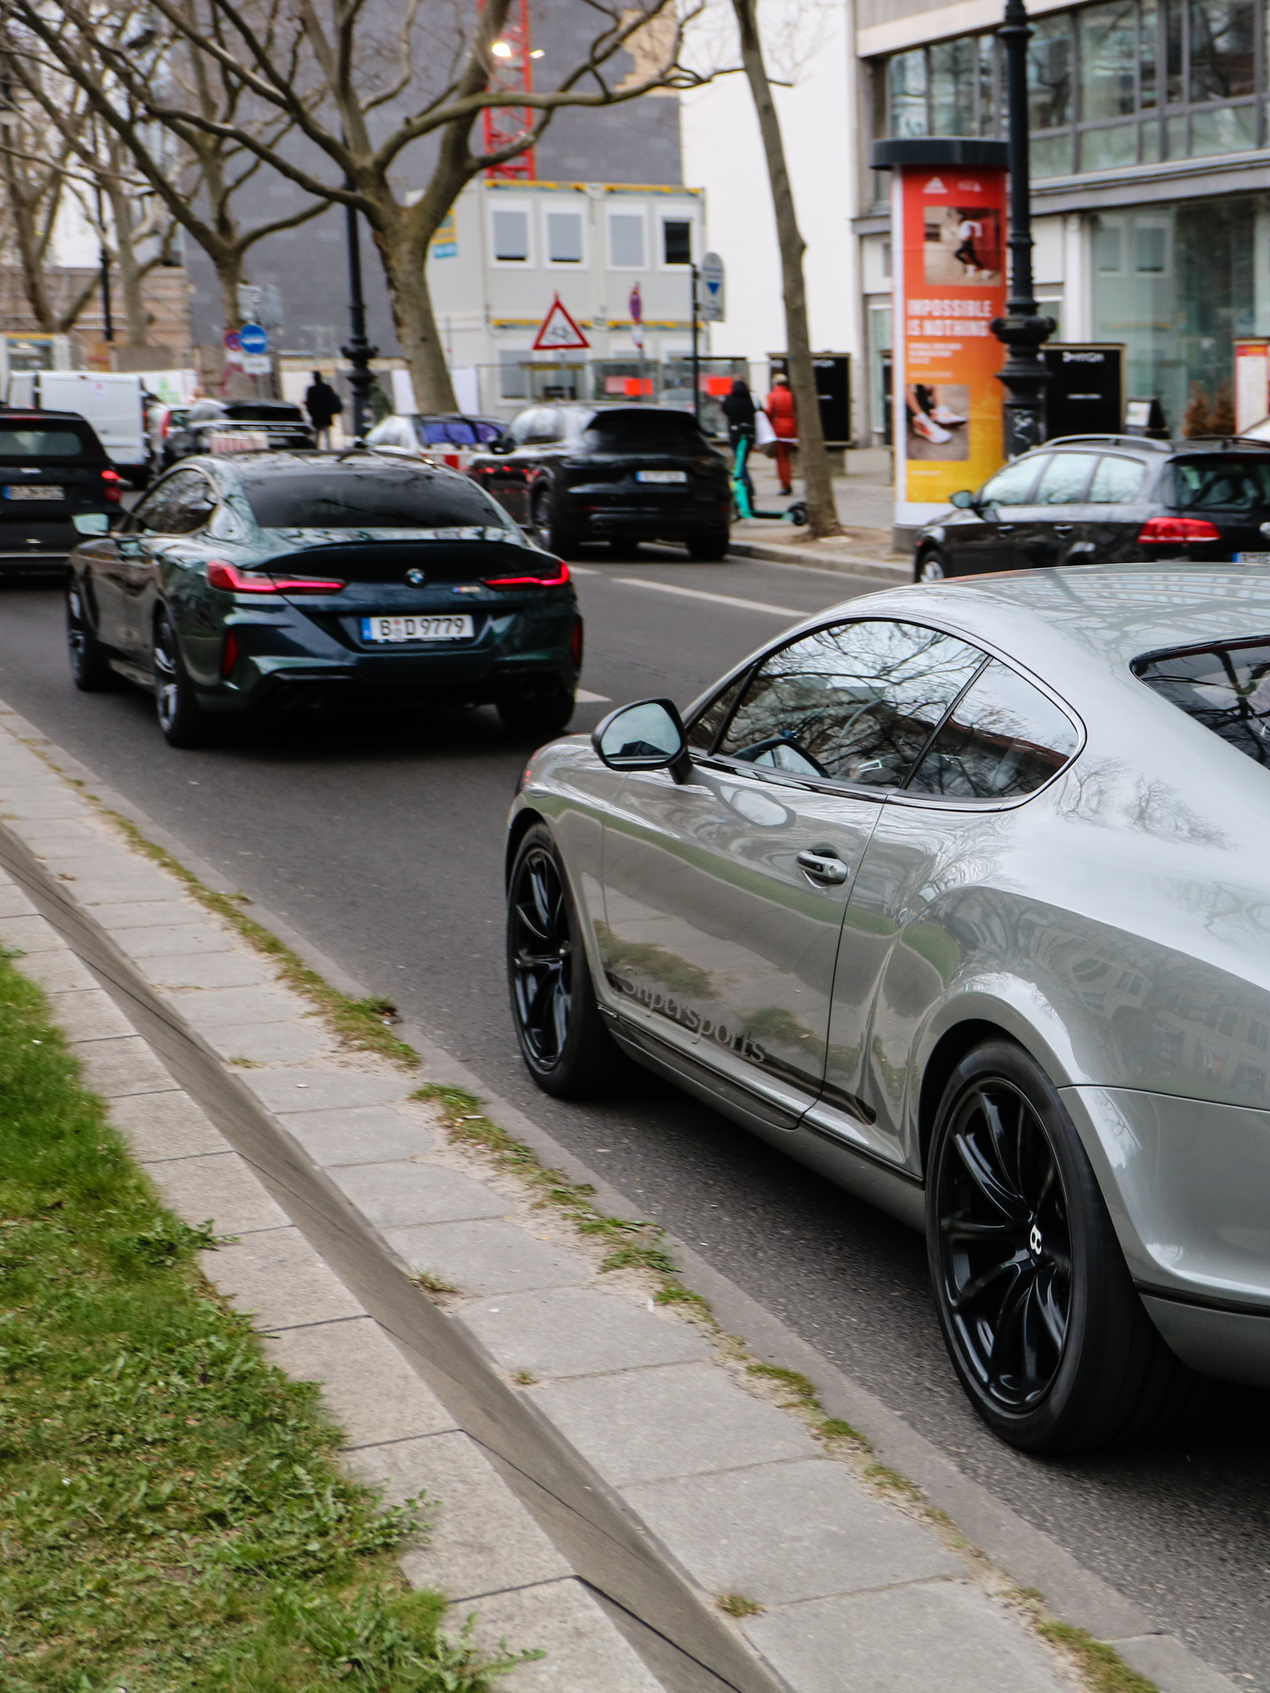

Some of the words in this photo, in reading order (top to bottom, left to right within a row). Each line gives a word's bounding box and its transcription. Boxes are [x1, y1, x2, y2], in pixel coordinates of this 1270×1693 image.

[906, 299, 993, 318] IMPOSSIBLE
[907, 319, 922, 336] IS
[922, 319, 990, 337] NOTHING
[380, 619, 393, 637] B
[404, 618, 416, 636] D
[420, 617, 465, 635] 9779
[621, 980, 766, 1063] Supersports
